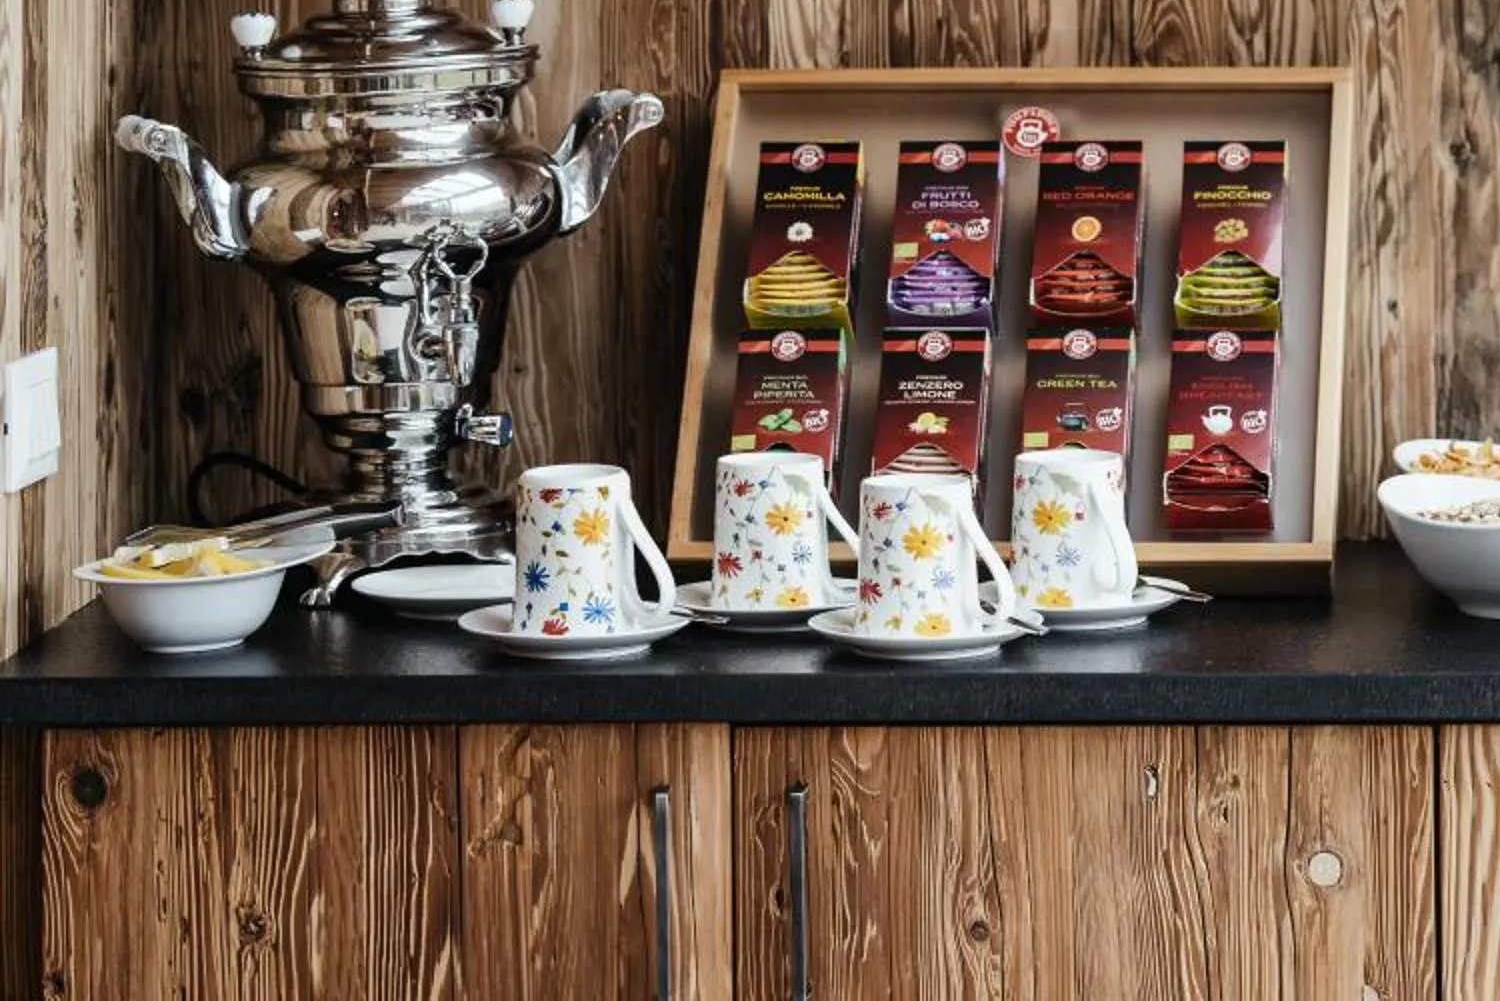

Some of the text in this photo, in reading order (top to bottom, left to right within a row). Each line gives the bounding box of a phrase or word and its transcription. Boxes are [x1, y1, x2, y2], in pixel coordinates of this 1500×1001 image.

[763, 192, 846, 201] CAMOMILLA
[921, 191, 971, 200] FRUTTI
[1043, 191, 1134, 200] RED ORANGE
[1194, 190, 1272, 200] FINOCCHIO
[912, 200, 980, 210] DI BOSCO
[761, 381, 808, 390] MENTA
[898, 381, 964, 390] ZENZERO
[1037, 380, 1118, 389] GREEN TEA
[753, 391, 815, 400] PIPERITA
[903, 391, 957, 399] LIMONE
